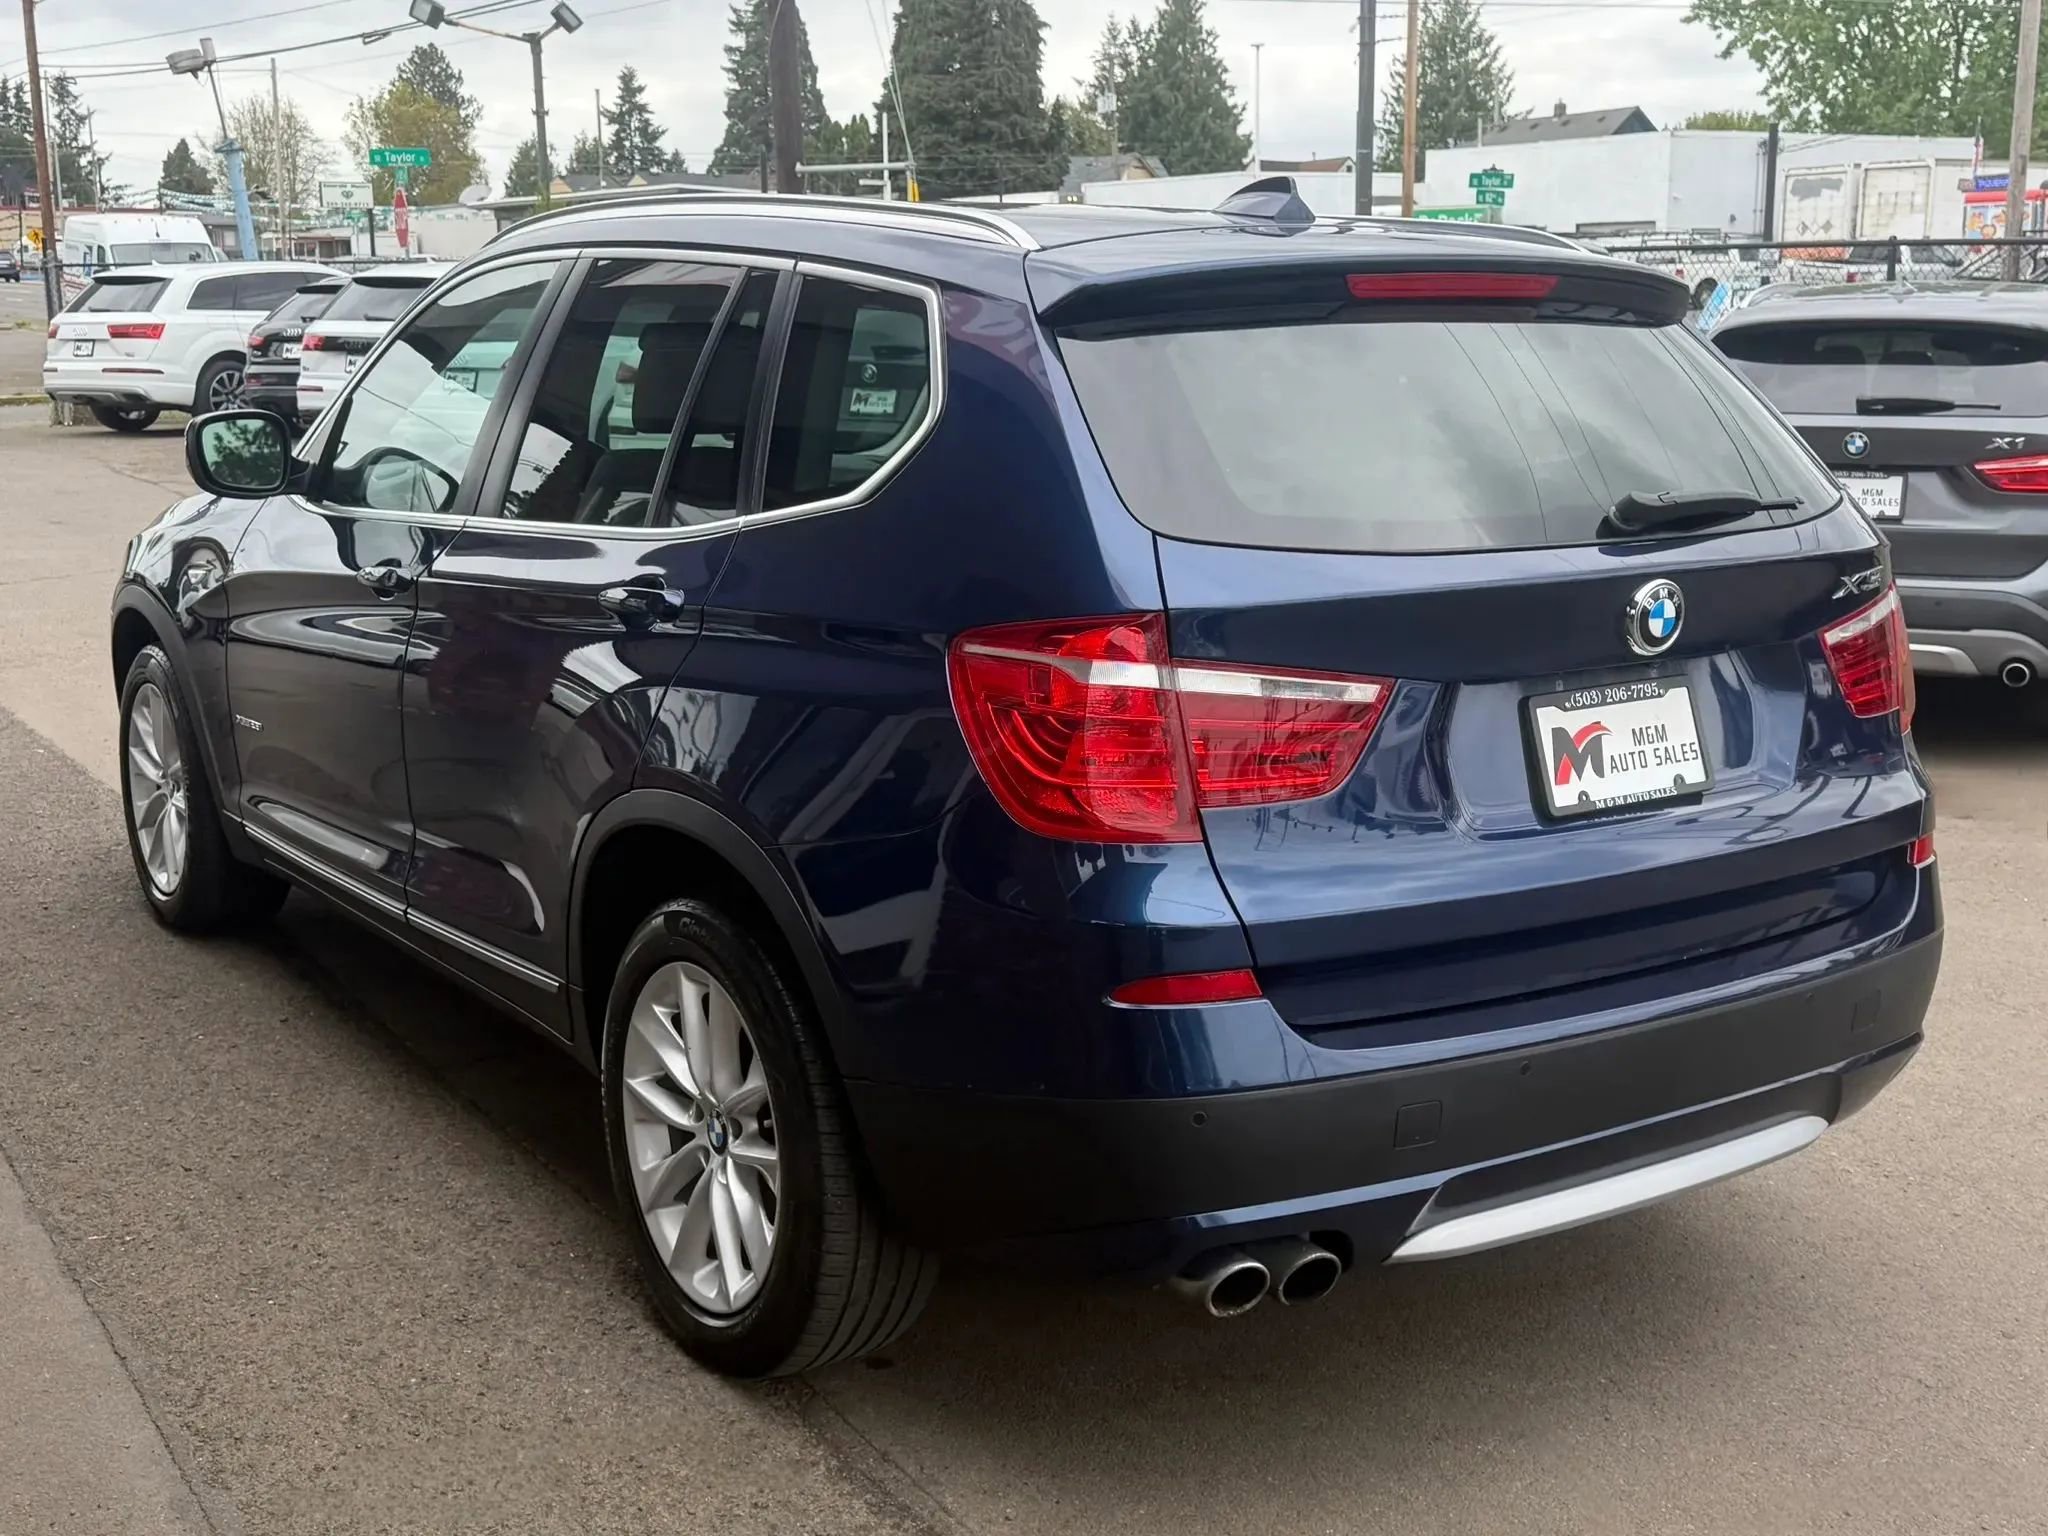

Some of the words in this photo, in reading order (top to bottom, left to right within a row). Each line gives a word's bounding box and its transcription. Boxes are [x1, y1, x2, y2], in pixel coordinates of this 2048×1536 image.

[384, 151, 416, 164] Taylor
[1985, 437, 2026, 449] X1
[1871, 497, 1900, 507] SALES
[1644, 587, 1681, 610] BMW
[1570, 689, 1602, 708] (503)
[1604, 682, 1659, 703] 206-7795
[1610, 750, 1648, 774] AUTO
[1653, 741, 1699, 767] SALES
[1594, 799, 1605, 809] M
[1614, 796, 1625, 806] M
[1626, 791, 1650, 804] AUTO
[1649, 786, 1678, 799] SALES
